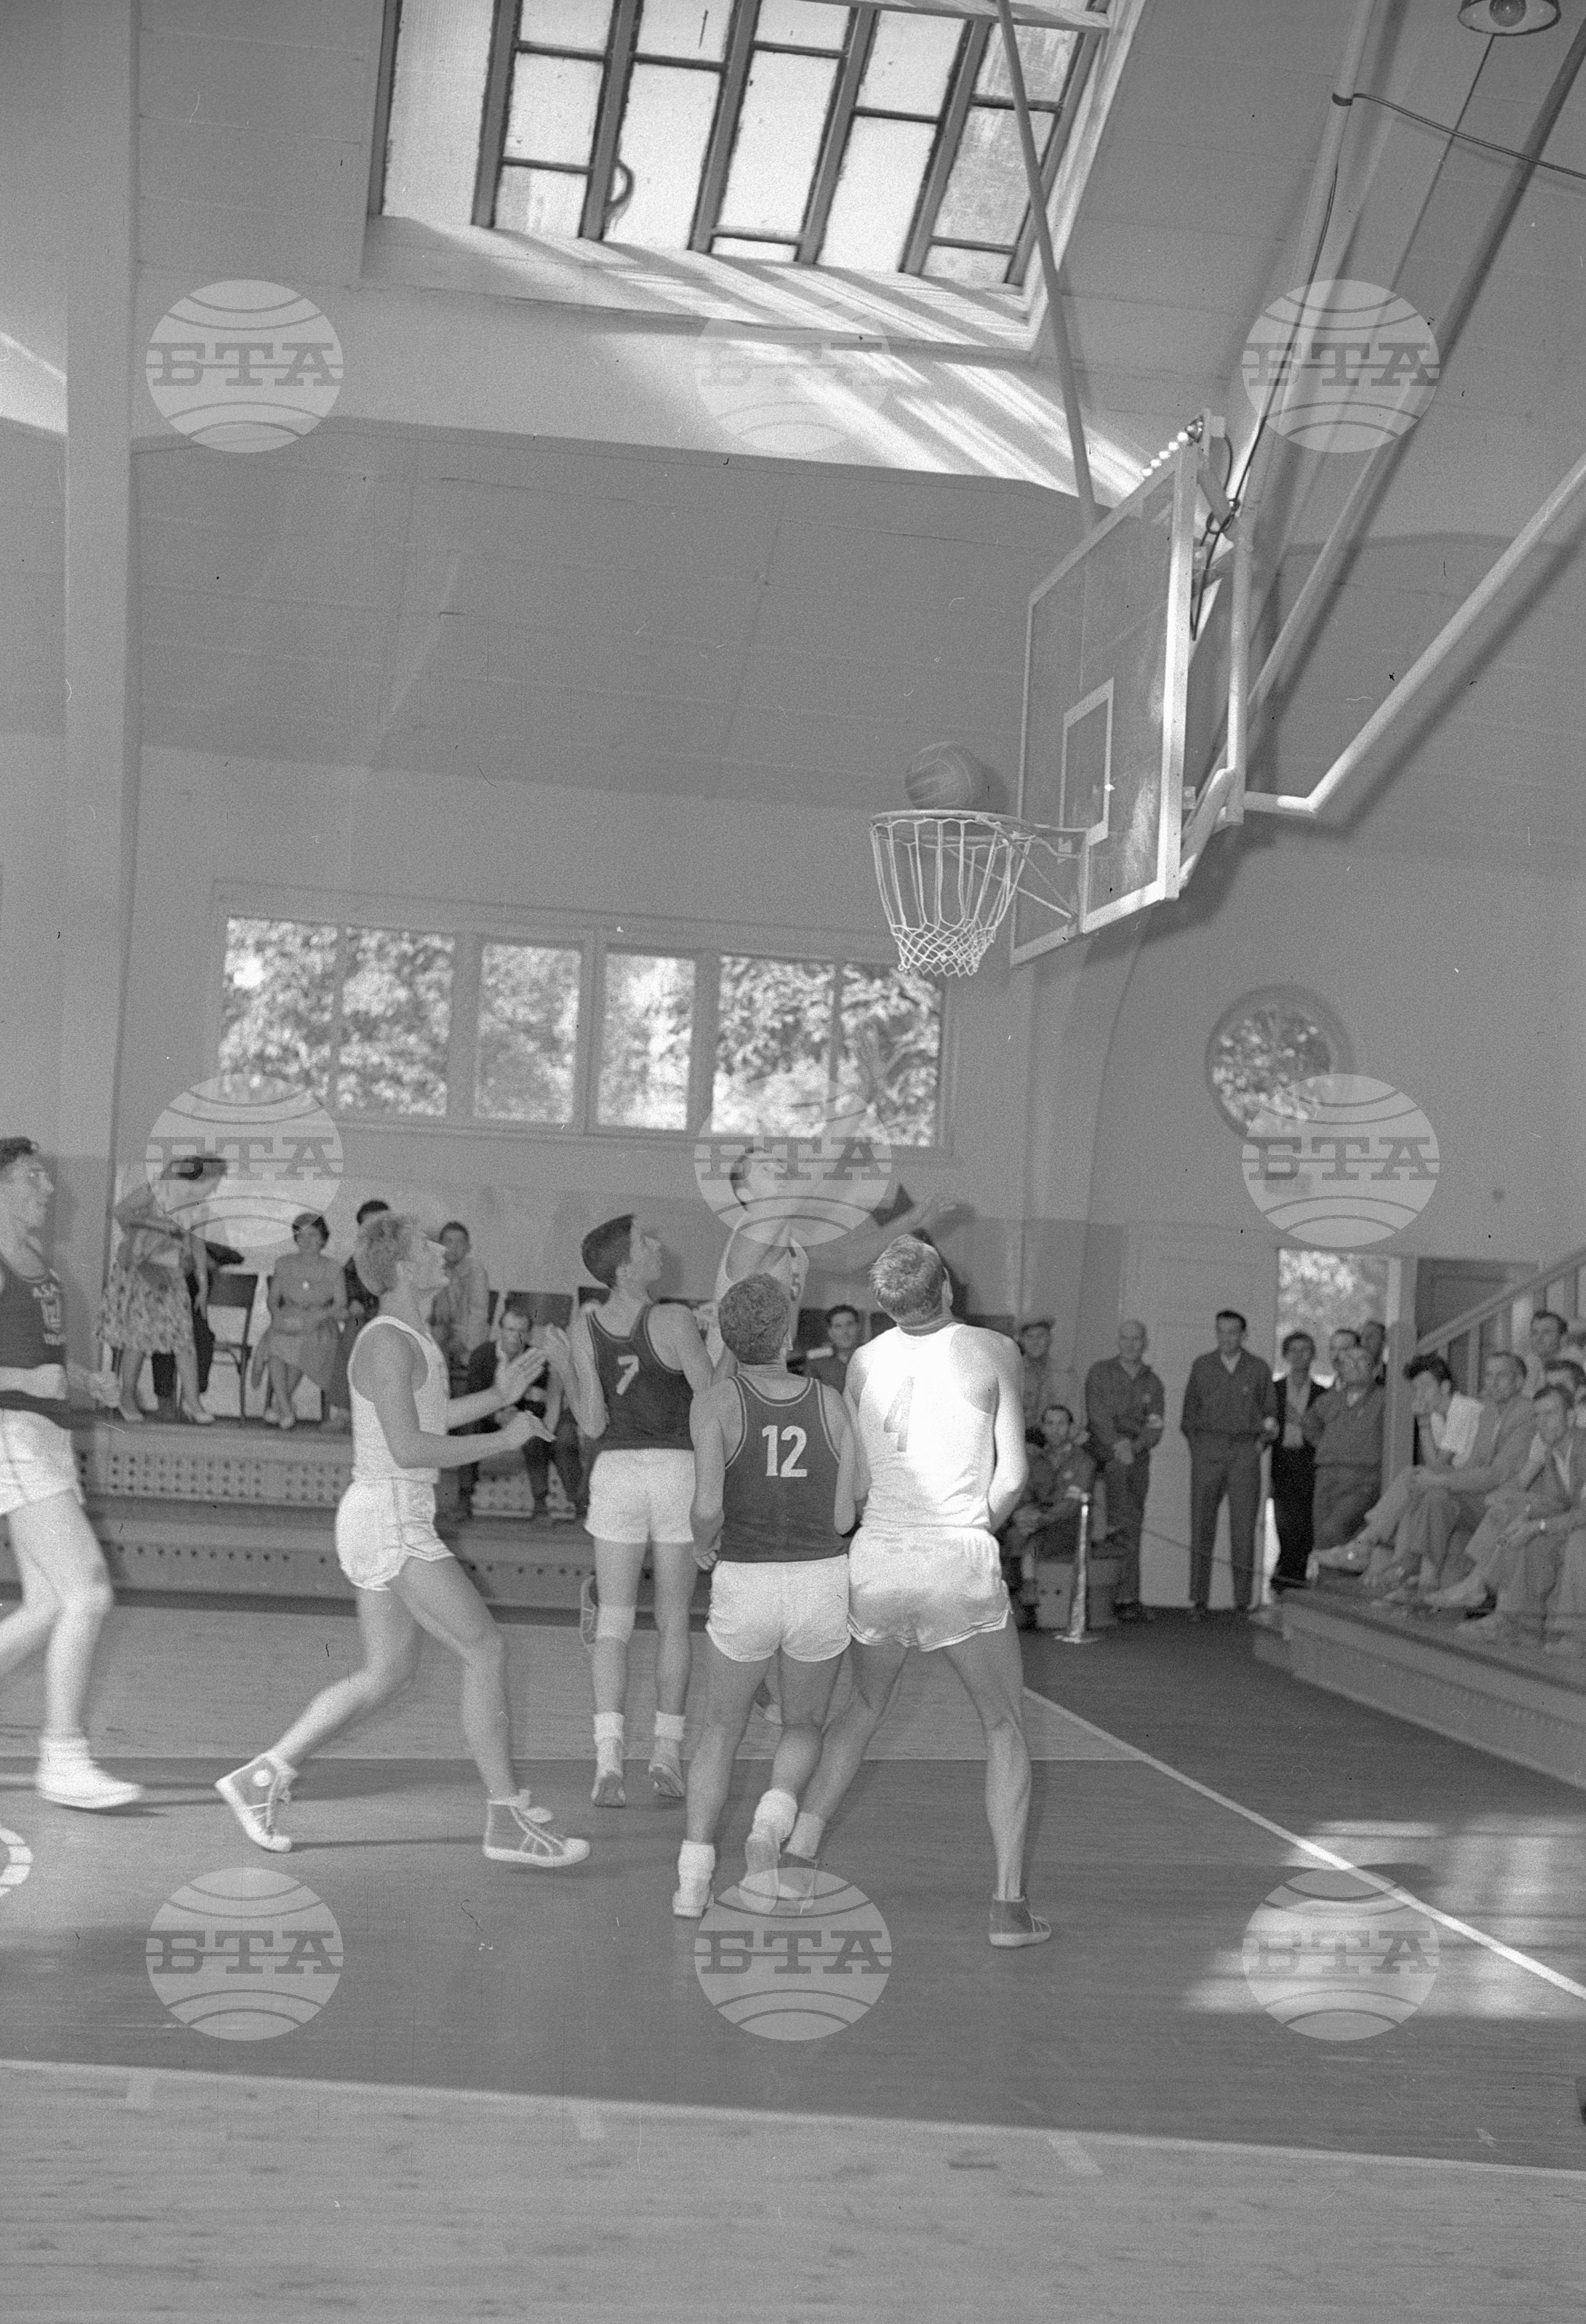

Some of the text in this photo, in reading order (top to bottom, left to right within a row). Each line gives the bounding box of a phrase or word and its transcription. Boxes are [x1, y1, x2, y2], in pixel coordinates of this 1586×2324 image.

[616, 1354, 639, 1396] 7
[883, 1375, 915, 1453] 4
[762, 1425, 808, 1477] 12
